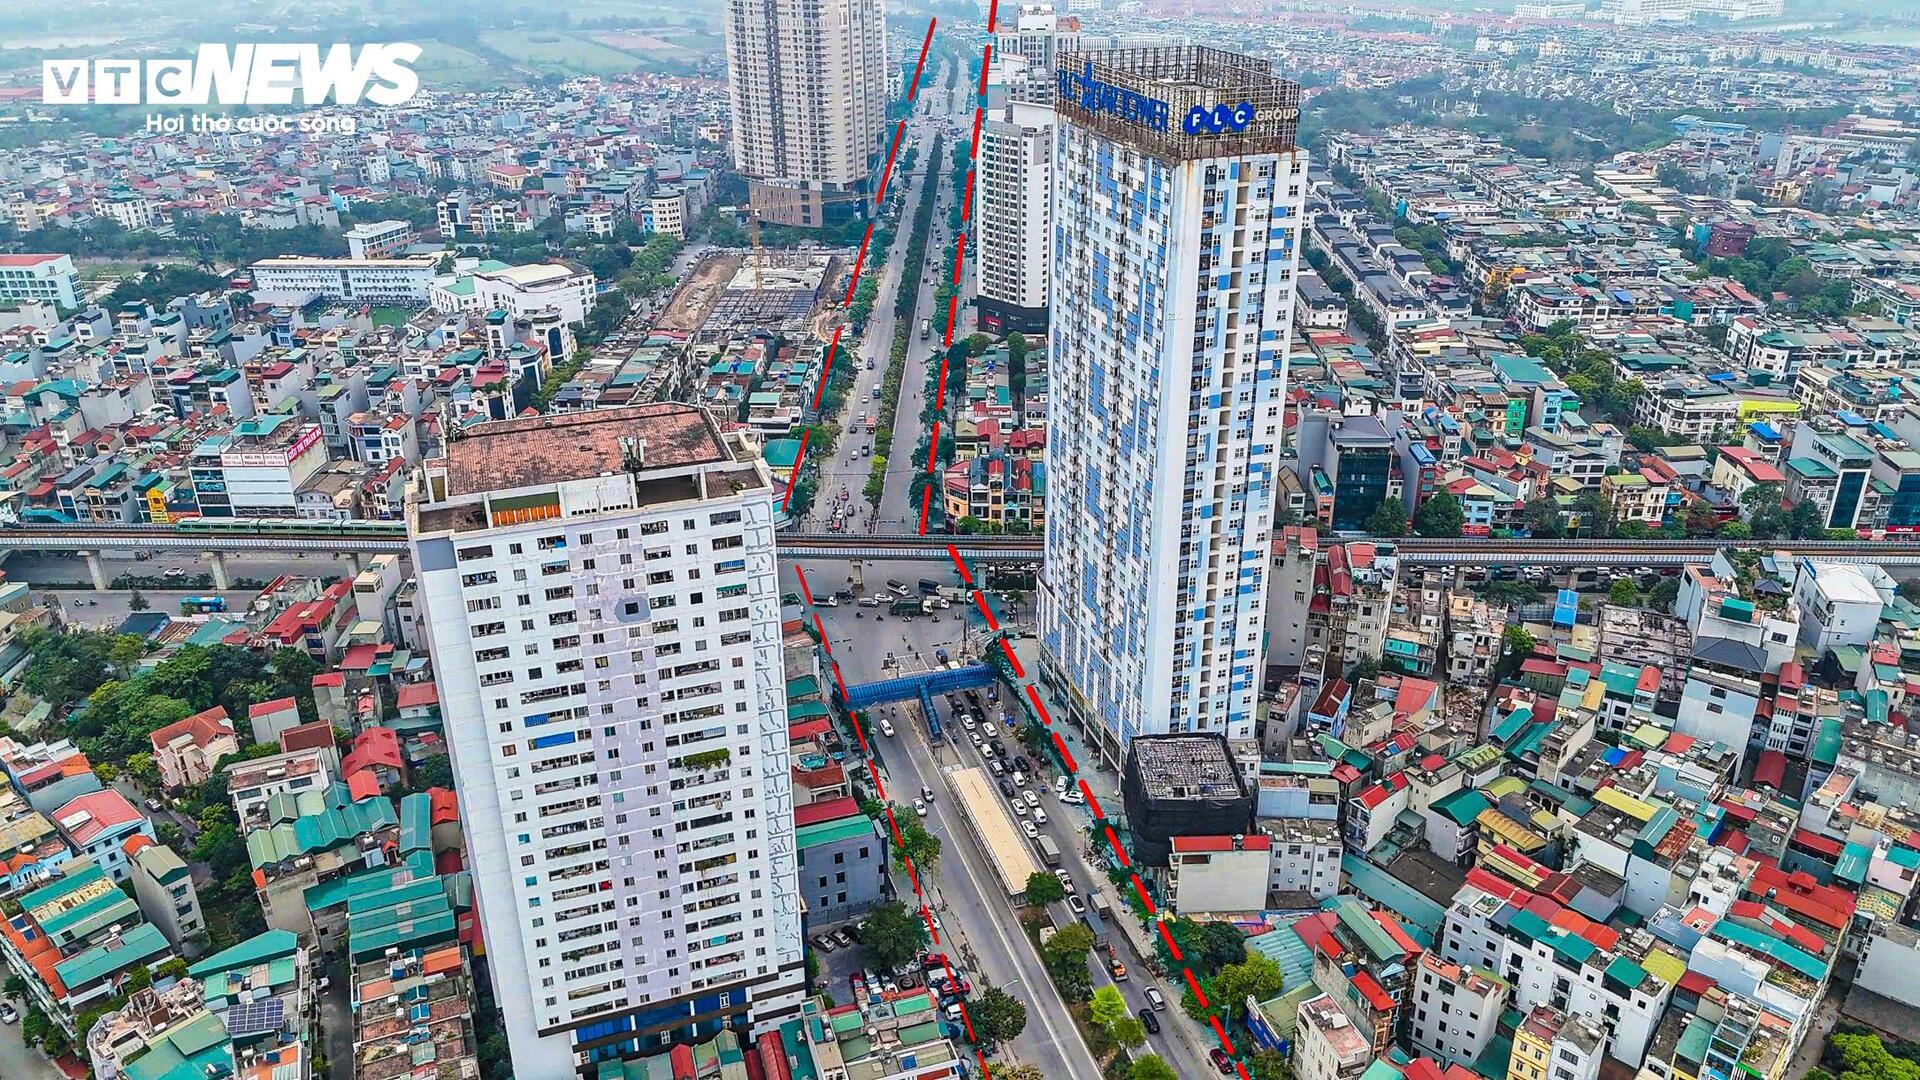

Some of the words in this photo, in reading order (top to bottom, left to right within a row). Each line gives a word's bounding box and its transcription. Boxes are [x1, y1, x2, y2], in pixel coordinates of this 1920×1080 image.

[1116, 87, 1169, 134] TOWER
[1191, 110, 1246, 128] FLC
[1254, 108, 1300, 123] GROUP
